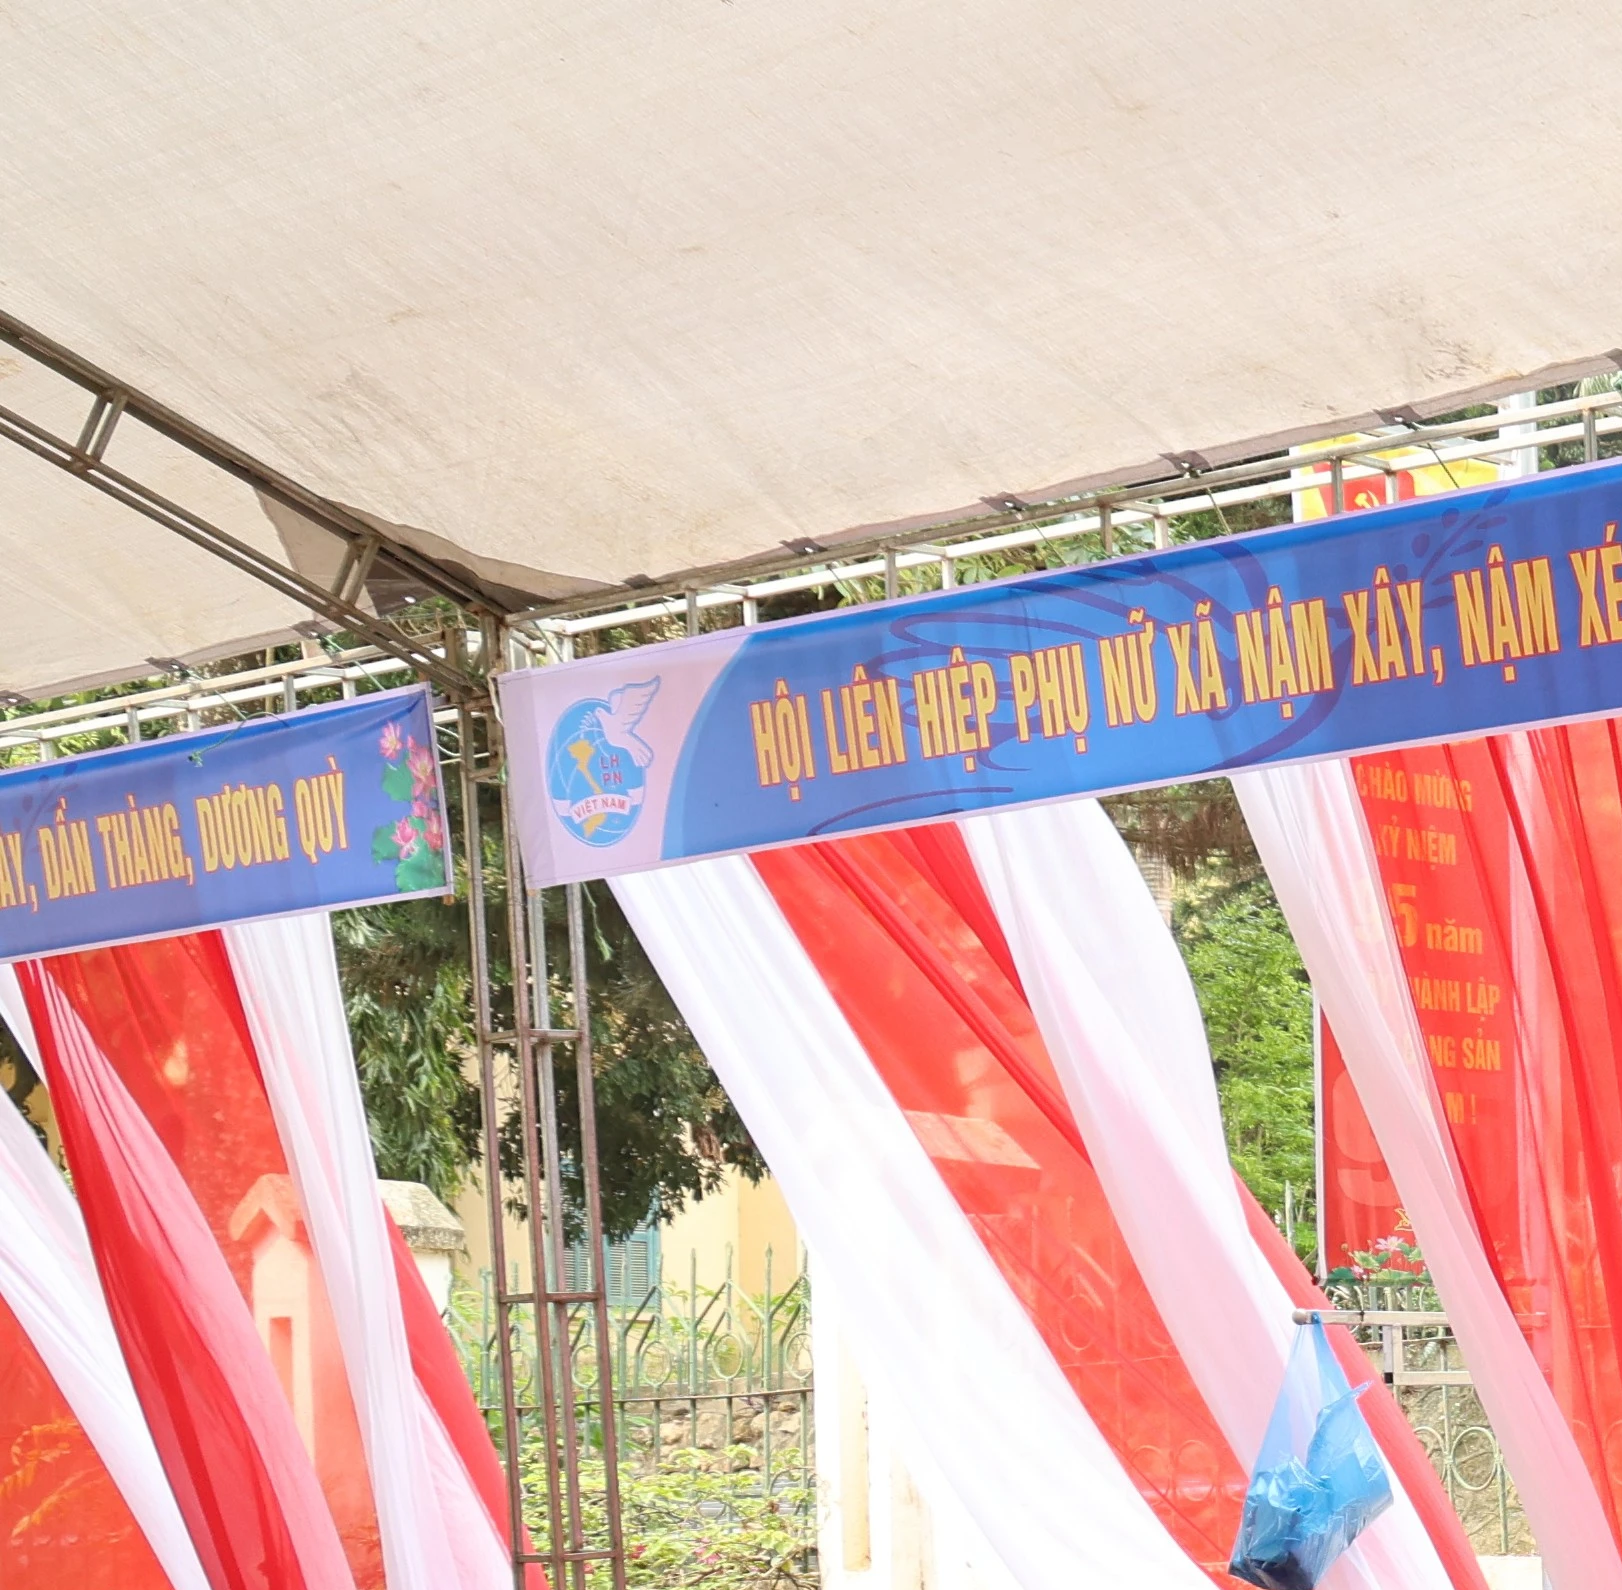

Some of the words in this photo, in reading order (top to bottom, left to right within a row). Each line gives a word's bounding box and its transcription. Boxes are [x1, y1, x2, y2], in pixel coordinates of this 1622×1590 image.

[750, 678, 816, 801] HỘI
[821, 664, 907, 775] LIÊN
[913, 645, 998, 772] HIỆP
[1009, 641, 1090, 754] PHỤ
[1099, 606, 1158, 727] NỮ
[1167, 600, 1227, 716] XÃ
[1234, 584, 1335, 719] NẬM
[1342, 565, 1445, 685] XÂY,
[1452, 544, 1561, 683] NẬM
[96, 793, 195, 888] THÀNG,
[195, 783, 289, 873] DƯƠNG
[294, 755, 348, 864] QUỲ
[601, 798, 626, 811] NAM
[1405, 825, 1457, 870] NIỆM
[1426, 918, 1483, 955] năm
[1466, 976, 1502, 1022] LẬP
[1462, 1028, 1502, 1071] SẢN
